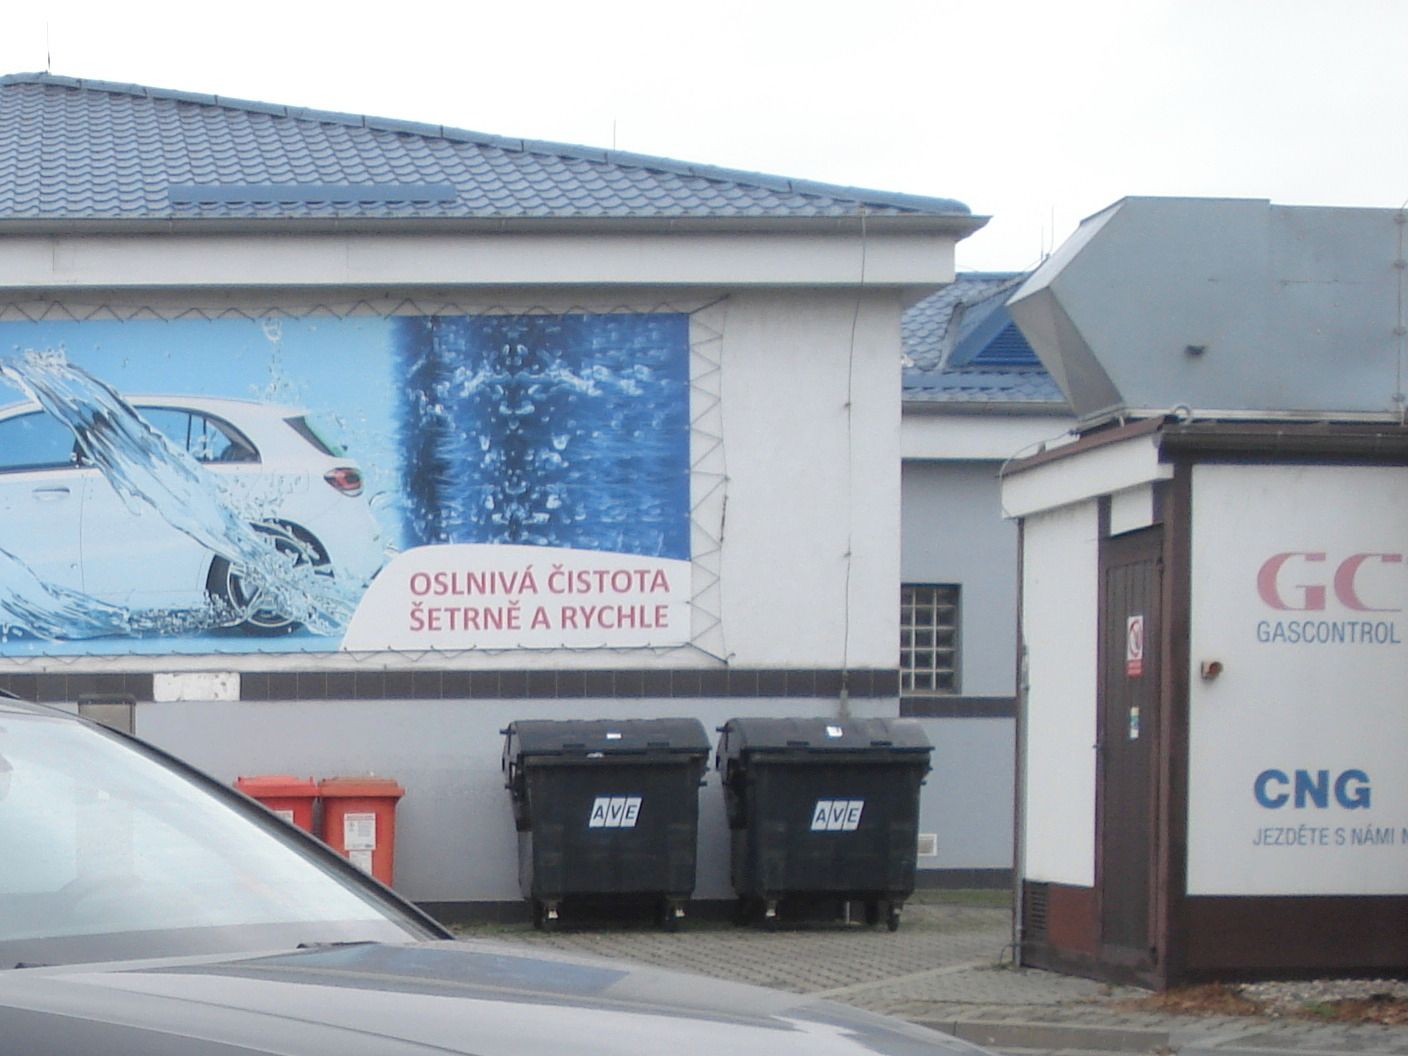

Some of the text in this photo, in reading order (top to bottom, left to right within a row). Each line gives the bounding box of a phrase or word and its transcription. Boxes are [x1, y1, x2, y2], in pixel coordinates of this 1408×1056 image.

[409, 564, 670, 597] OSLNIVÁ ČISTOTA
[409, 600, 669, 631] ŠETRNĚ A RYCHLE
[1256, 620, 1402, 644] GASCONTROL
[1253, 768, 1371, 810] CNG
[593, 804, 637, 820] AVE
[815, 808, 859, 823] AVE
[1335, 827, 1346, 846] S
[1351, 824, 1394, 846] NÁMI
